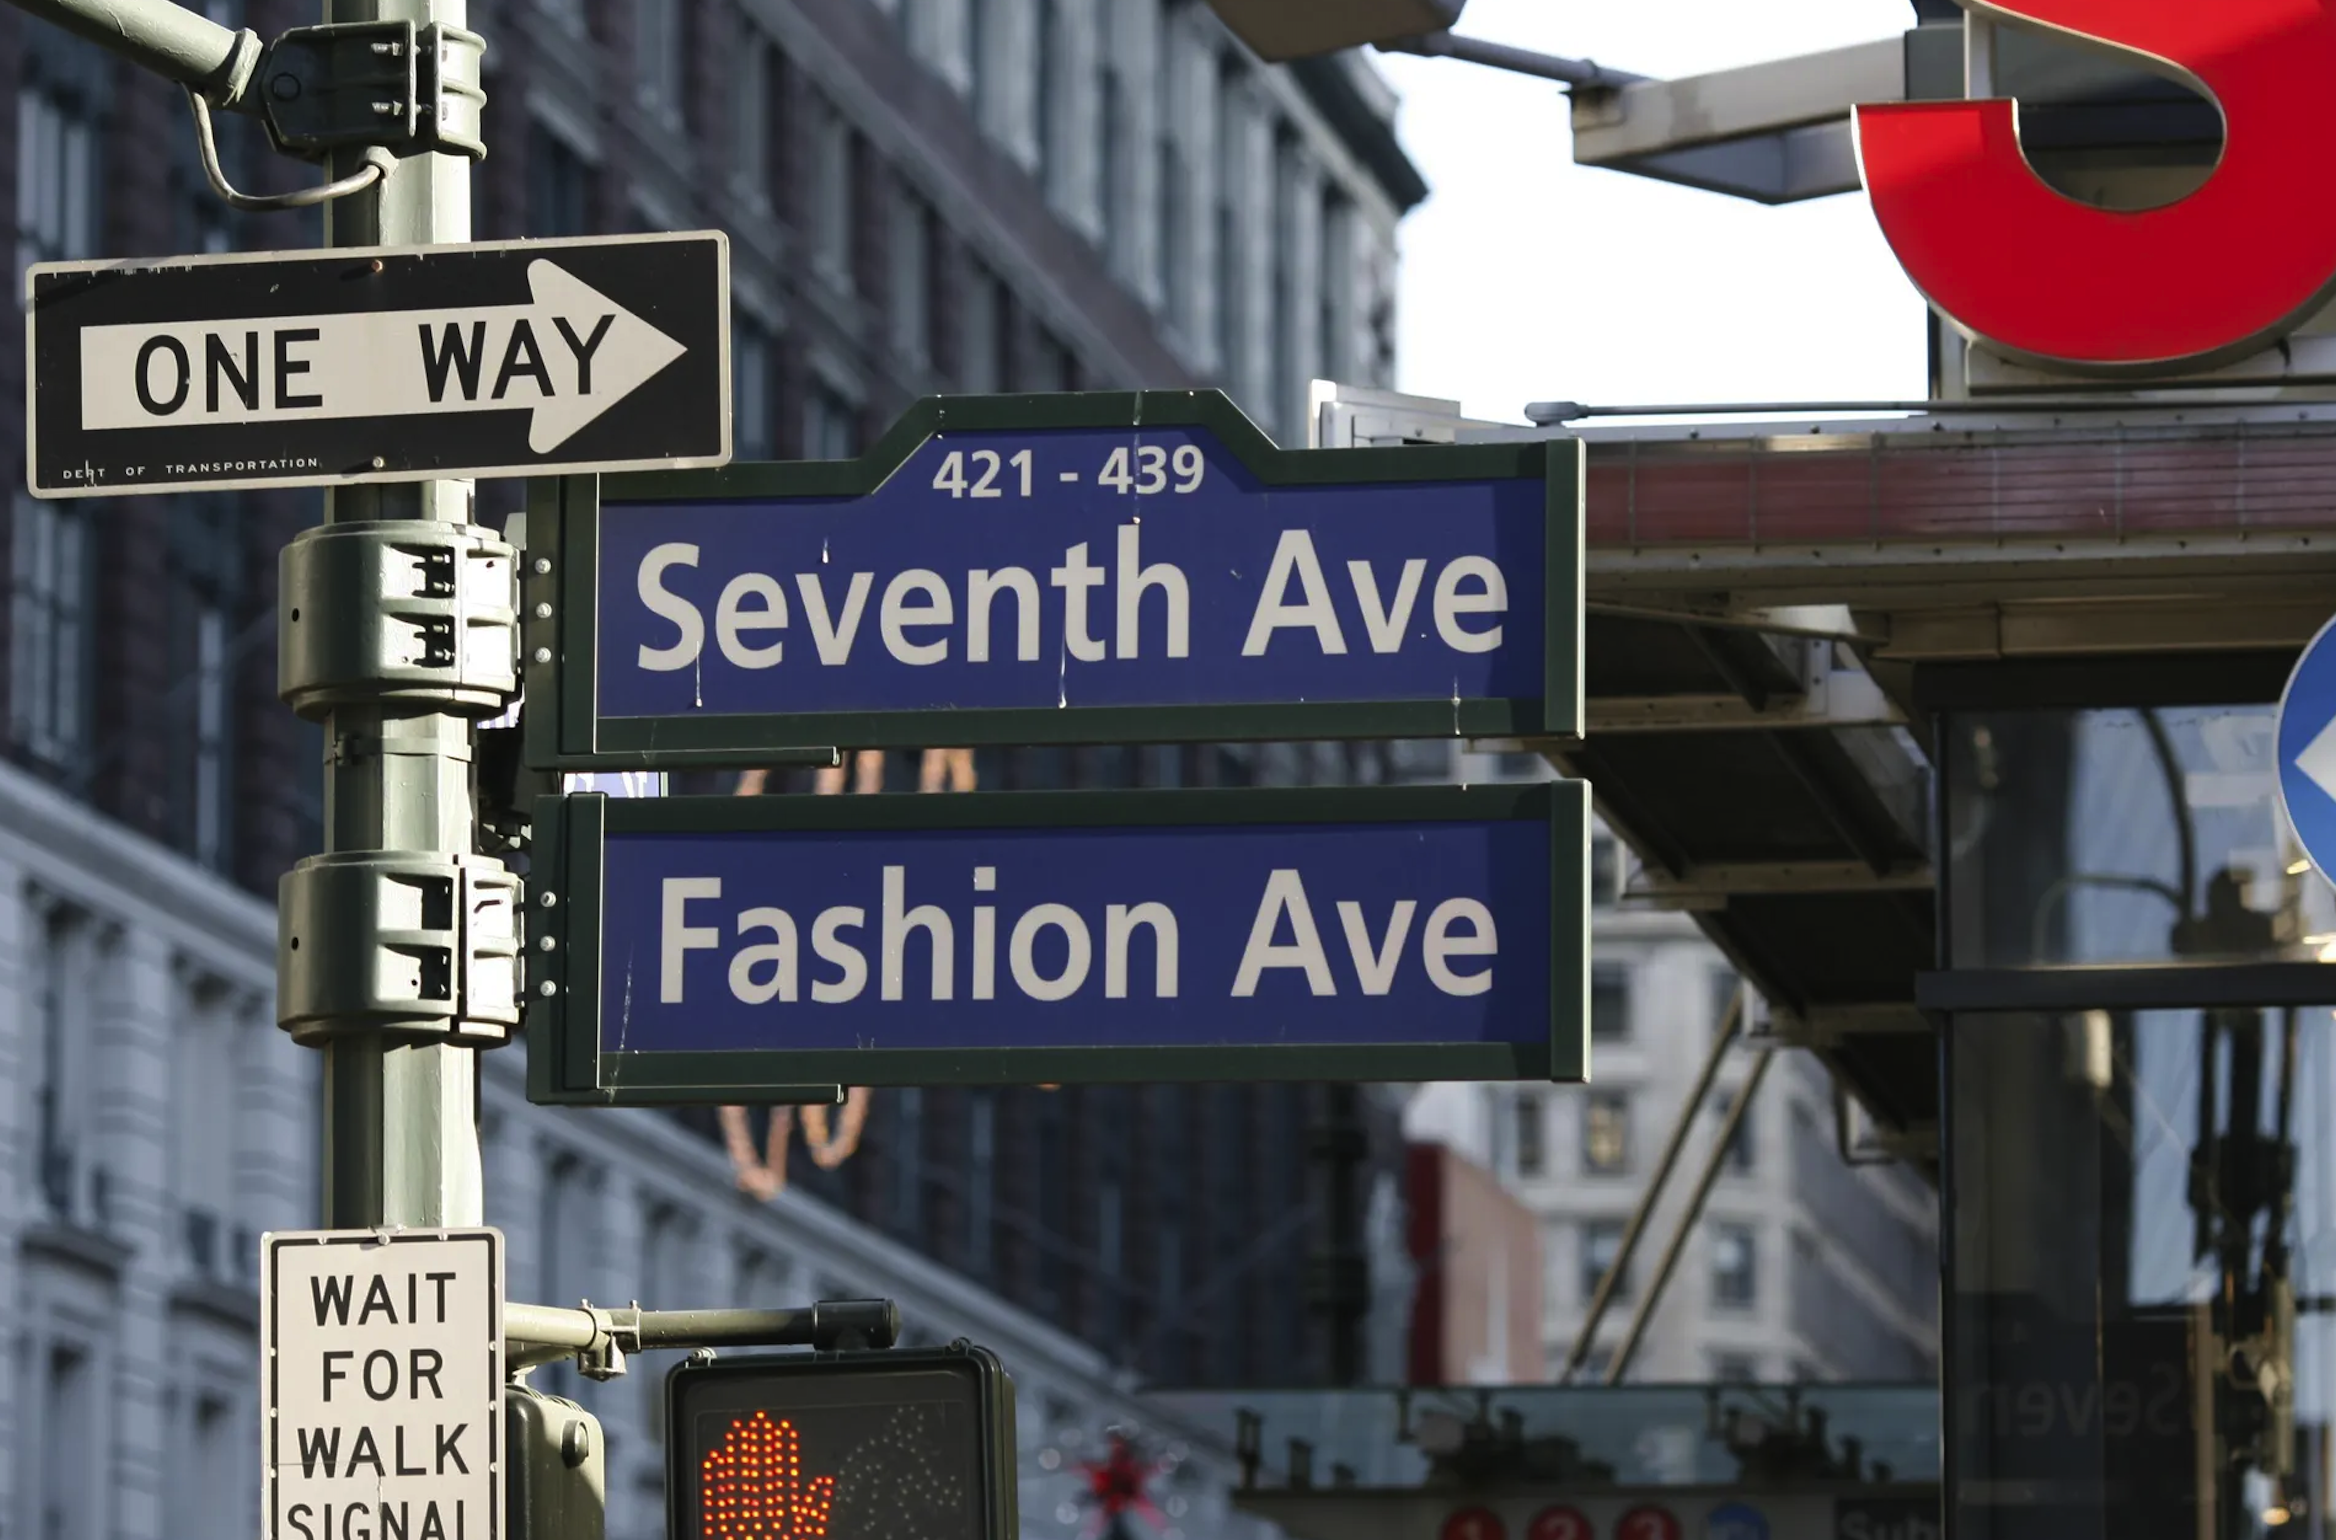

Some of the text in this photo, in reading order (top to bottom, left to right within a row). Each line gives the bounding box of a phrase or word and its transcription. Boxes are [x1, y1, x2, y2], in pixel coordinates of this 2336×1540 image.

[135, 314, 616, 416] ONE WAY
[125, 465, 146, 477] OF
[165, 457, 319, 474] TRANSPORTATION
[932, 443, 1205, 499] 421 - 439
[636, 523, 1510, 672] Seventh Ave
[659, 864, 1499, 1004] Fashion Ave
[309, 1271, 458, 1327] WAIT
[321, 1348, 444, 1402] FOR
[297, 1423, 470, 1479] WALK
